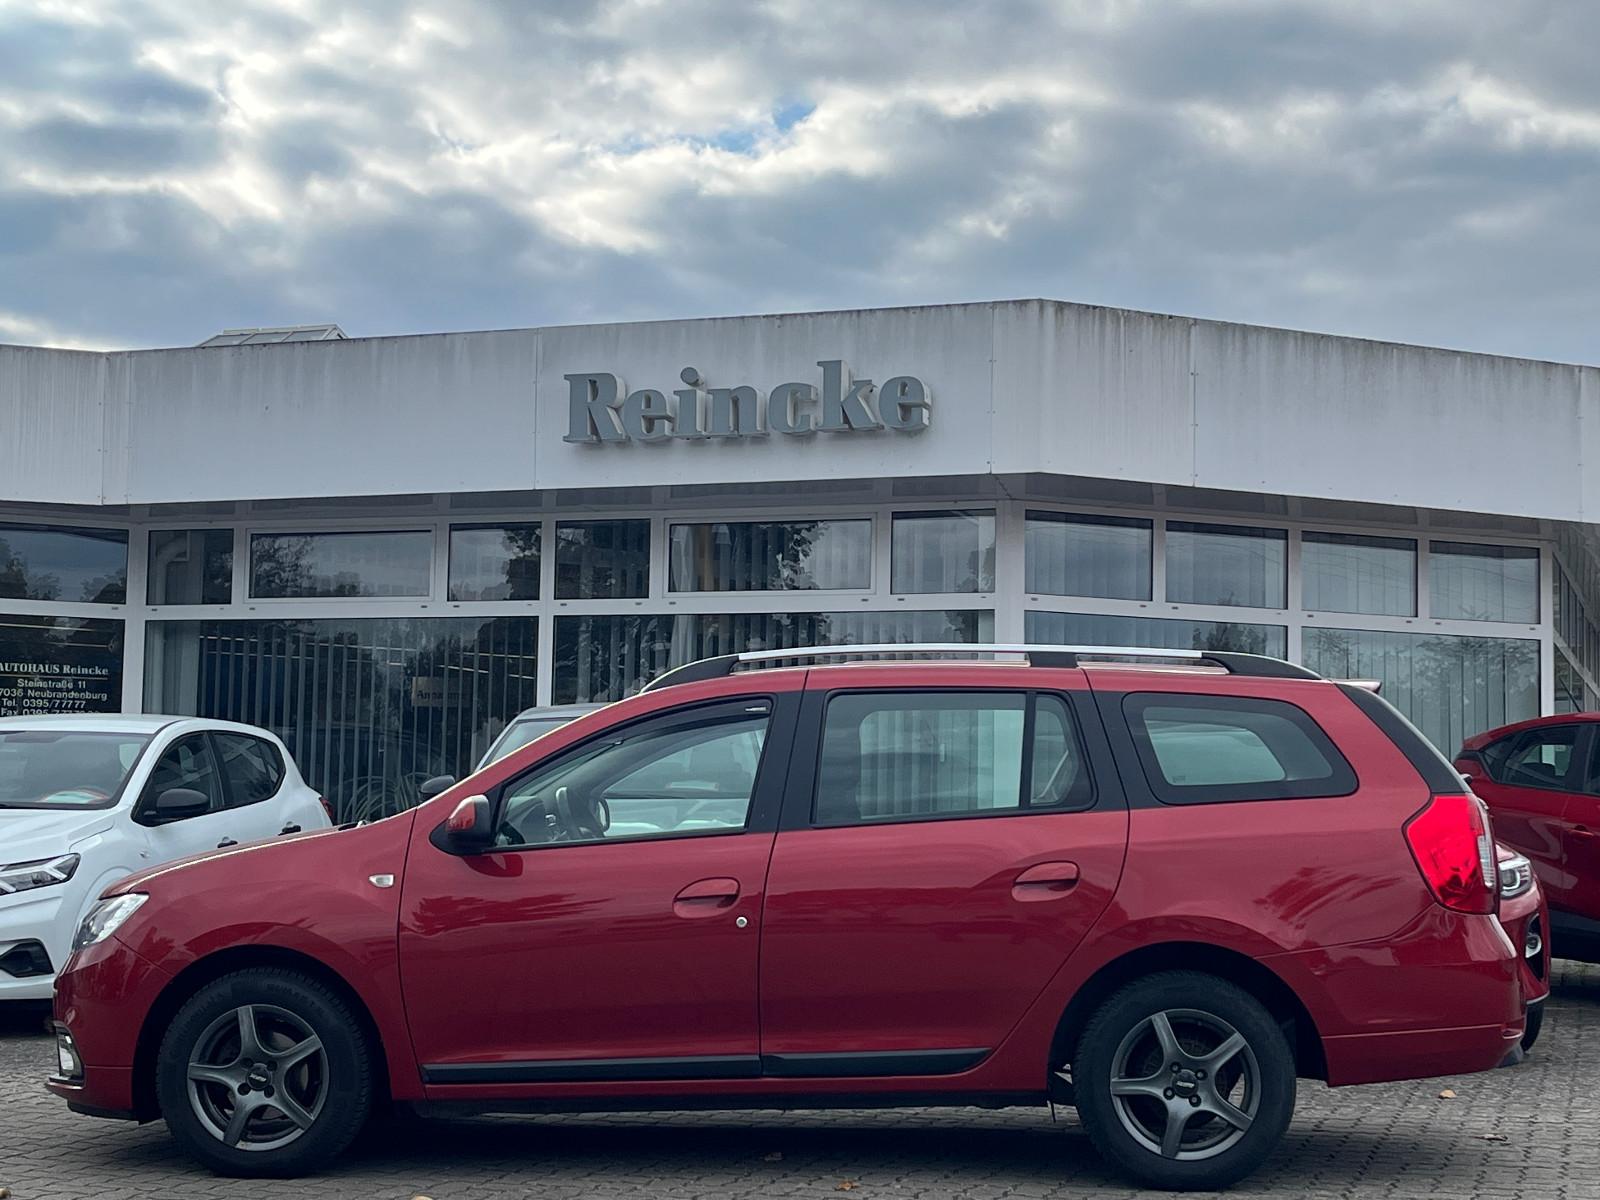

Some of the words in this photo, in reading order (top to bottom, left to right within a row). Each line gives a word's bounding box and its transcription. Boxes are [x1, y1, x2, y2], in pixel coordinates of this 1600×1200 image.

[563, 359, 932, 443] Reincke
[62, 664, 109, 675] Reincke
[17, 678, 74, 689] Steinstraße
[78, 680, 86, 689] 11
[27, 689, 108, 702] Neubrandenburg
